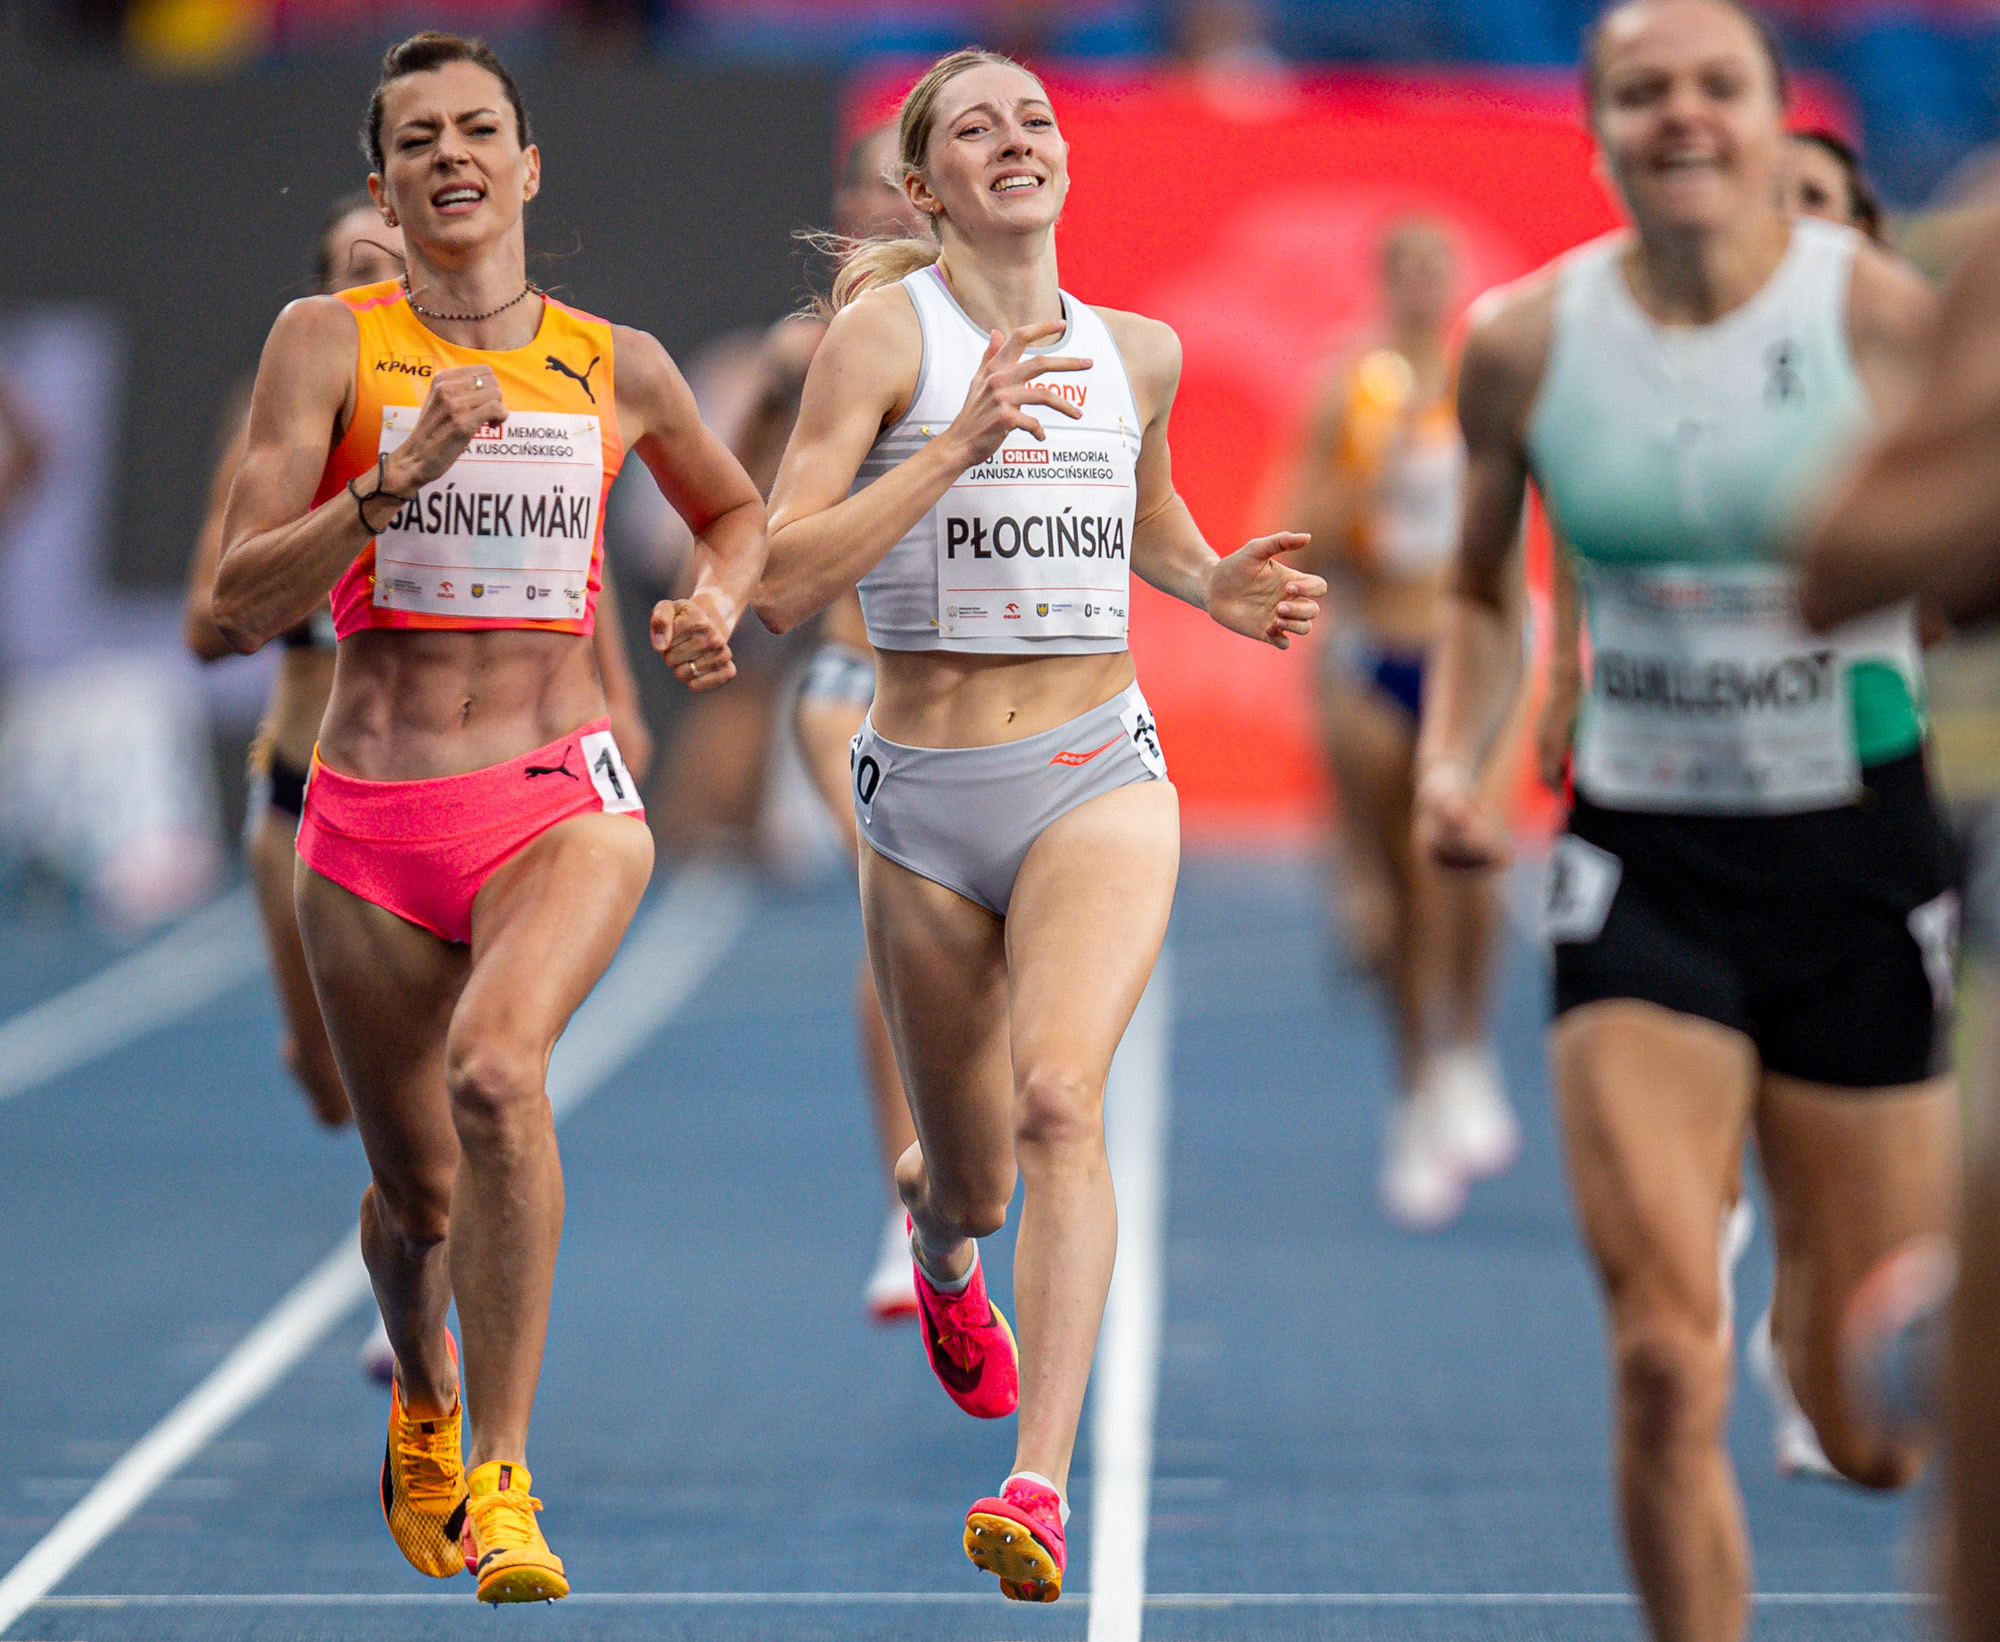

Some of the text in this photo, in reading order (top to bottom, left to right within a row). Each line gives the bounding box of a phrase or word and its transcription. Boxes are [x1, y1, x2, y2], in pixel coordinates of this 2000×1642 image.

[375, 359, 432, 377] KPMG
[507, 427, 569, 440] MEMORIAŁ
[476, 442, 574, 457] KUSOCIŃSKIEGO
[1005, 451, 1047, 463] ORLEN
[1053, 451, 1110, 462] MEMORIAŁ
[970, 465, 1114, 480] JANUSZA KUSOCIŃSKIEGO
[520, 485, 591, 540] MÄKI
[947, 506, 1125, 560] PŁOCIŃSKA
